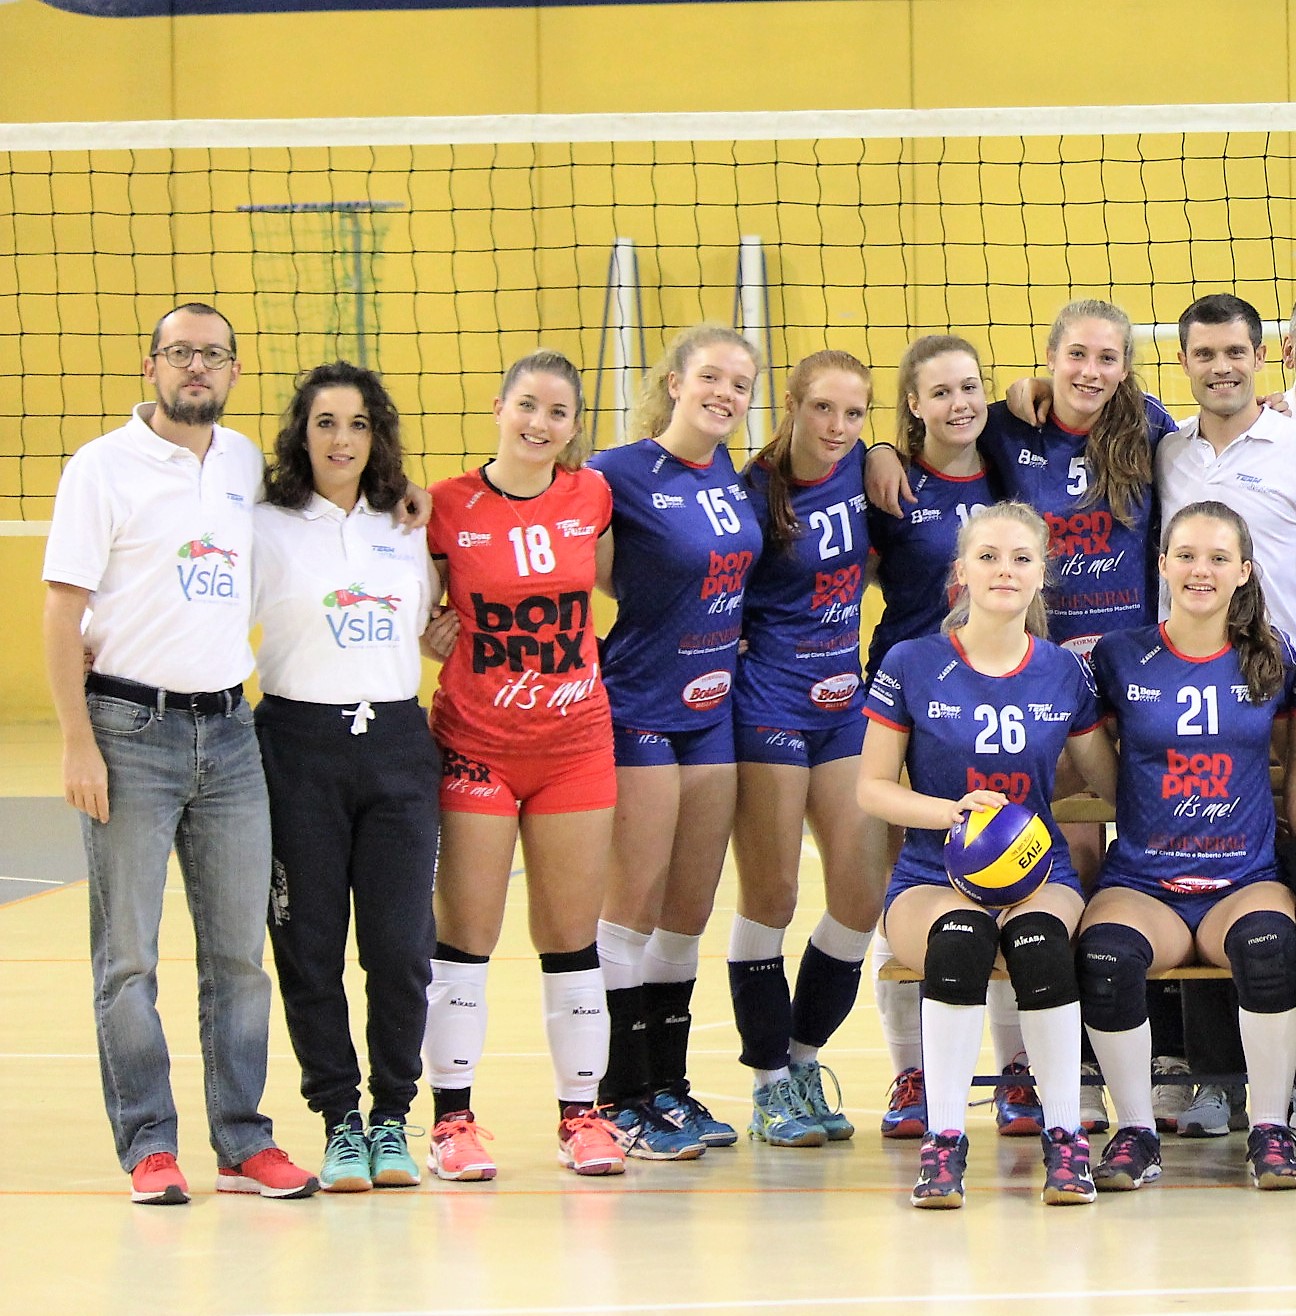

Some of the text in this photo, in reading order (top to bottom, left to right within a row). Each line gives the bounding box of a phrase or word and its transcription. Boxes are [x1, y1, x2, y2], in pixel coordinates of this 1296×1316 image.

[1066, 457, 1089, 496] 5
[696, 488, 741, 536] 15
[1043, 511, 1112, 536] bon
[809, 501, 853, 561] 27
[508, 524, 557, 577] 18
[709, 550, 753, 577] bon
[1061, 550, 1125, 580] it's me!
[815, 564, 862, 594] bon
[470, 590, 589, 633] bon
[472, 631, 587, 675] prix
[1073, 637, 1099, 647] FORMA
[493, 669, 545, 710] it's
[1027, 703, 1053, 712] TEAM
[1176, 685, 1219, 736] 21
[973, 703, 1027, 754] 26
[1166, 748, 1233, 776] bon
[966, 767, 1032, 800] bon
[1161, 774, 1230, 799] prix
[1173, 794, 1241, 824] it's me!
[942, 921, 974, 933] MIKASA
[1014, 934, 1046, 948] MIKASA
[1247, 933, 1278, 945] macron
[1086, 952, 1118, 964] macron
